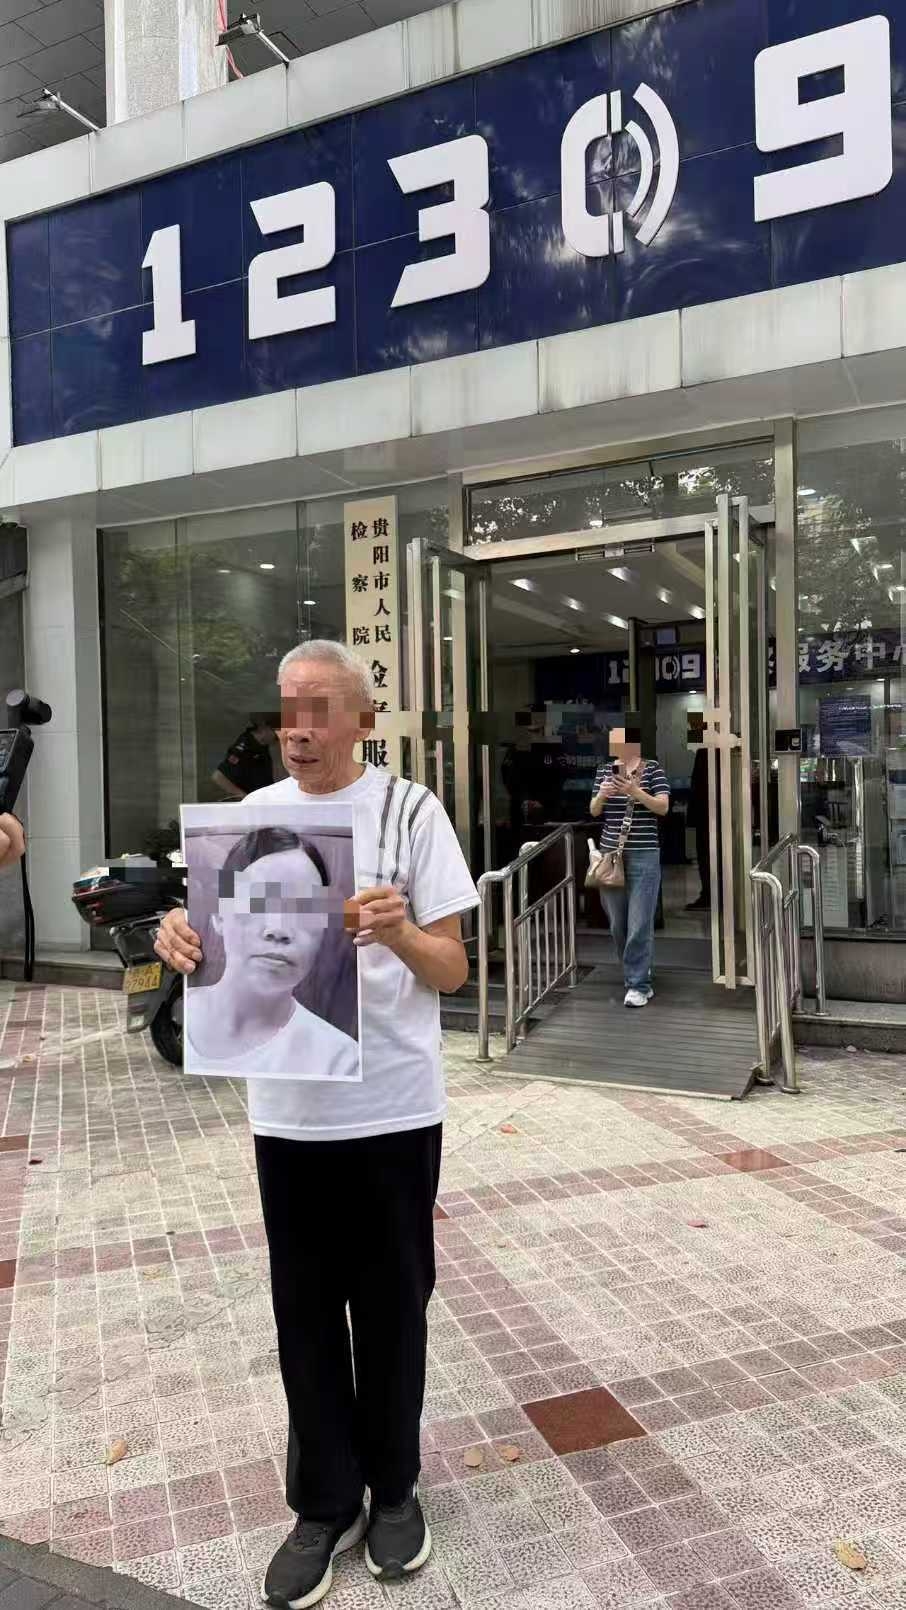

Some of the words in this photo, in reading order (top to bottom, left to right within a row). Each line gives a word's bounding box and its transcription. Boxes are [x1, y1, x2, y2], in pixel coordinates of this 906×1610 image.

[141, 14, 893, 366] 12309
[350, 521, 370, 645] 检察院
[371, 518, 391, 643] 贵阳市人民
